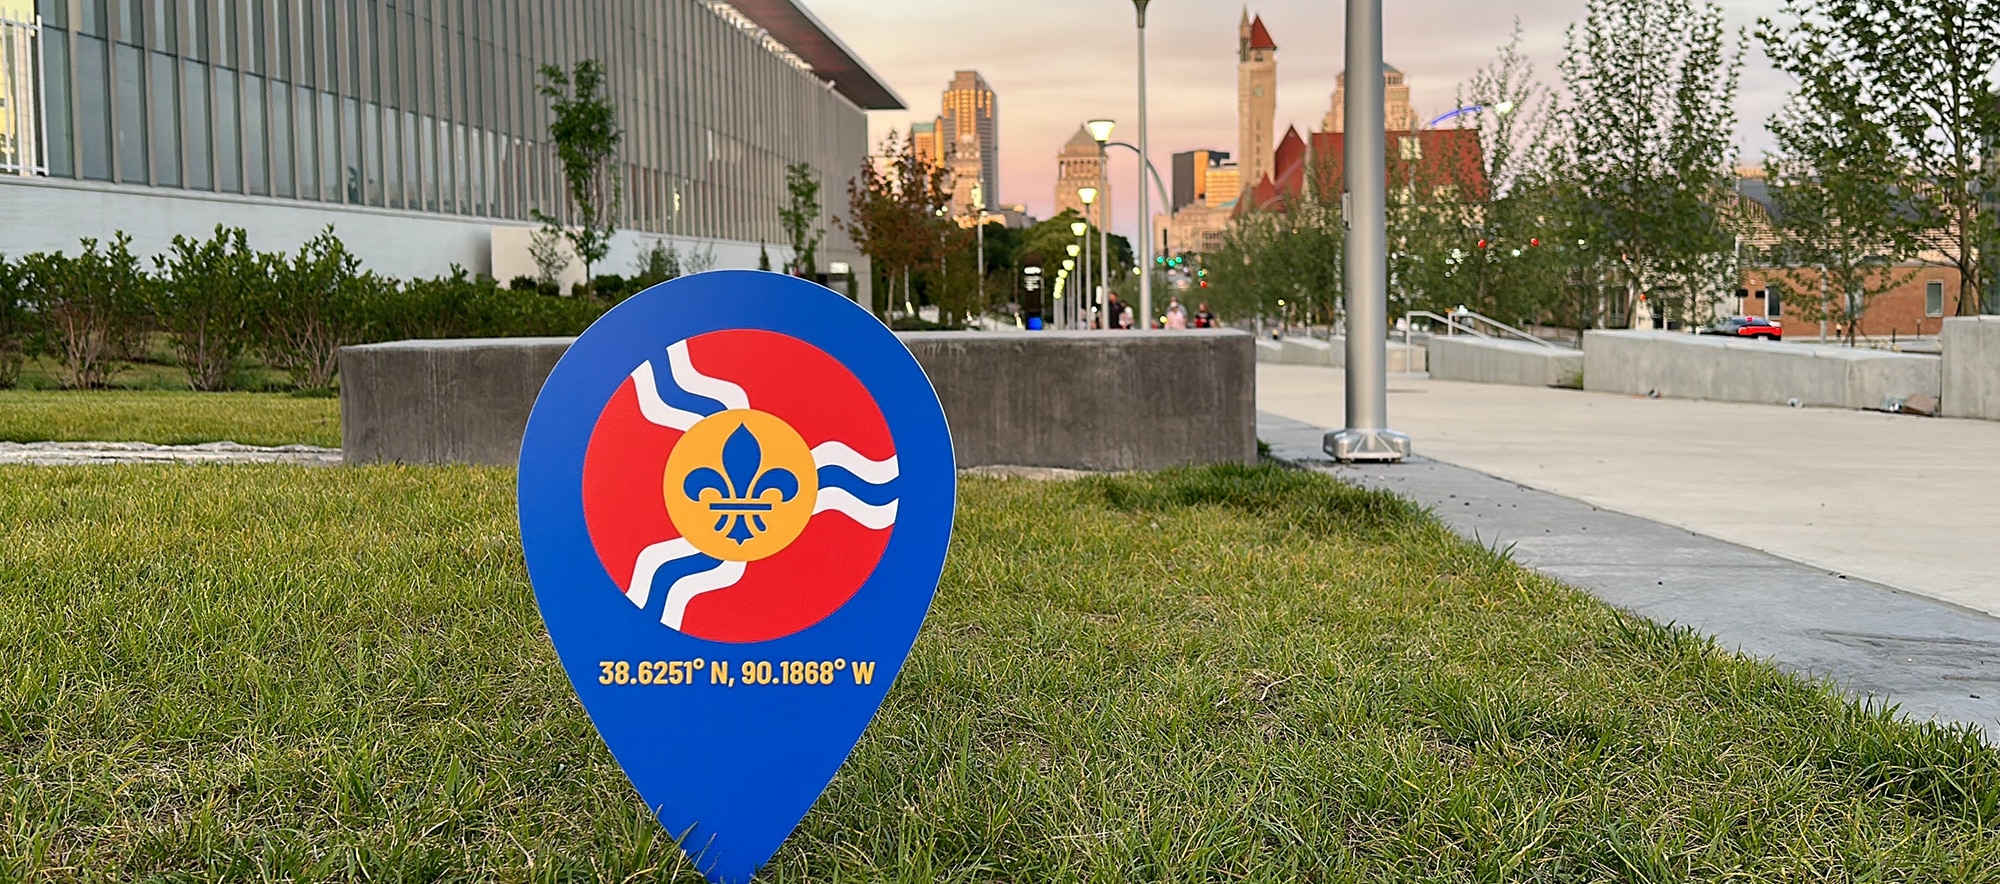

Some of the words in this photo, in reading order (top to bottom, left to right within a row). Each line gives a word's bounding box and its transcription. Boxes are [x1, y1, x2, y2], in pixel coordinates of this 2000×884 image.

[598, 657, 705, 685] 38.6251°
[710, 660, 735, 688] N,
[741, 657, 846, 685] 90.1868°
[851, 660, 876, 685] W
